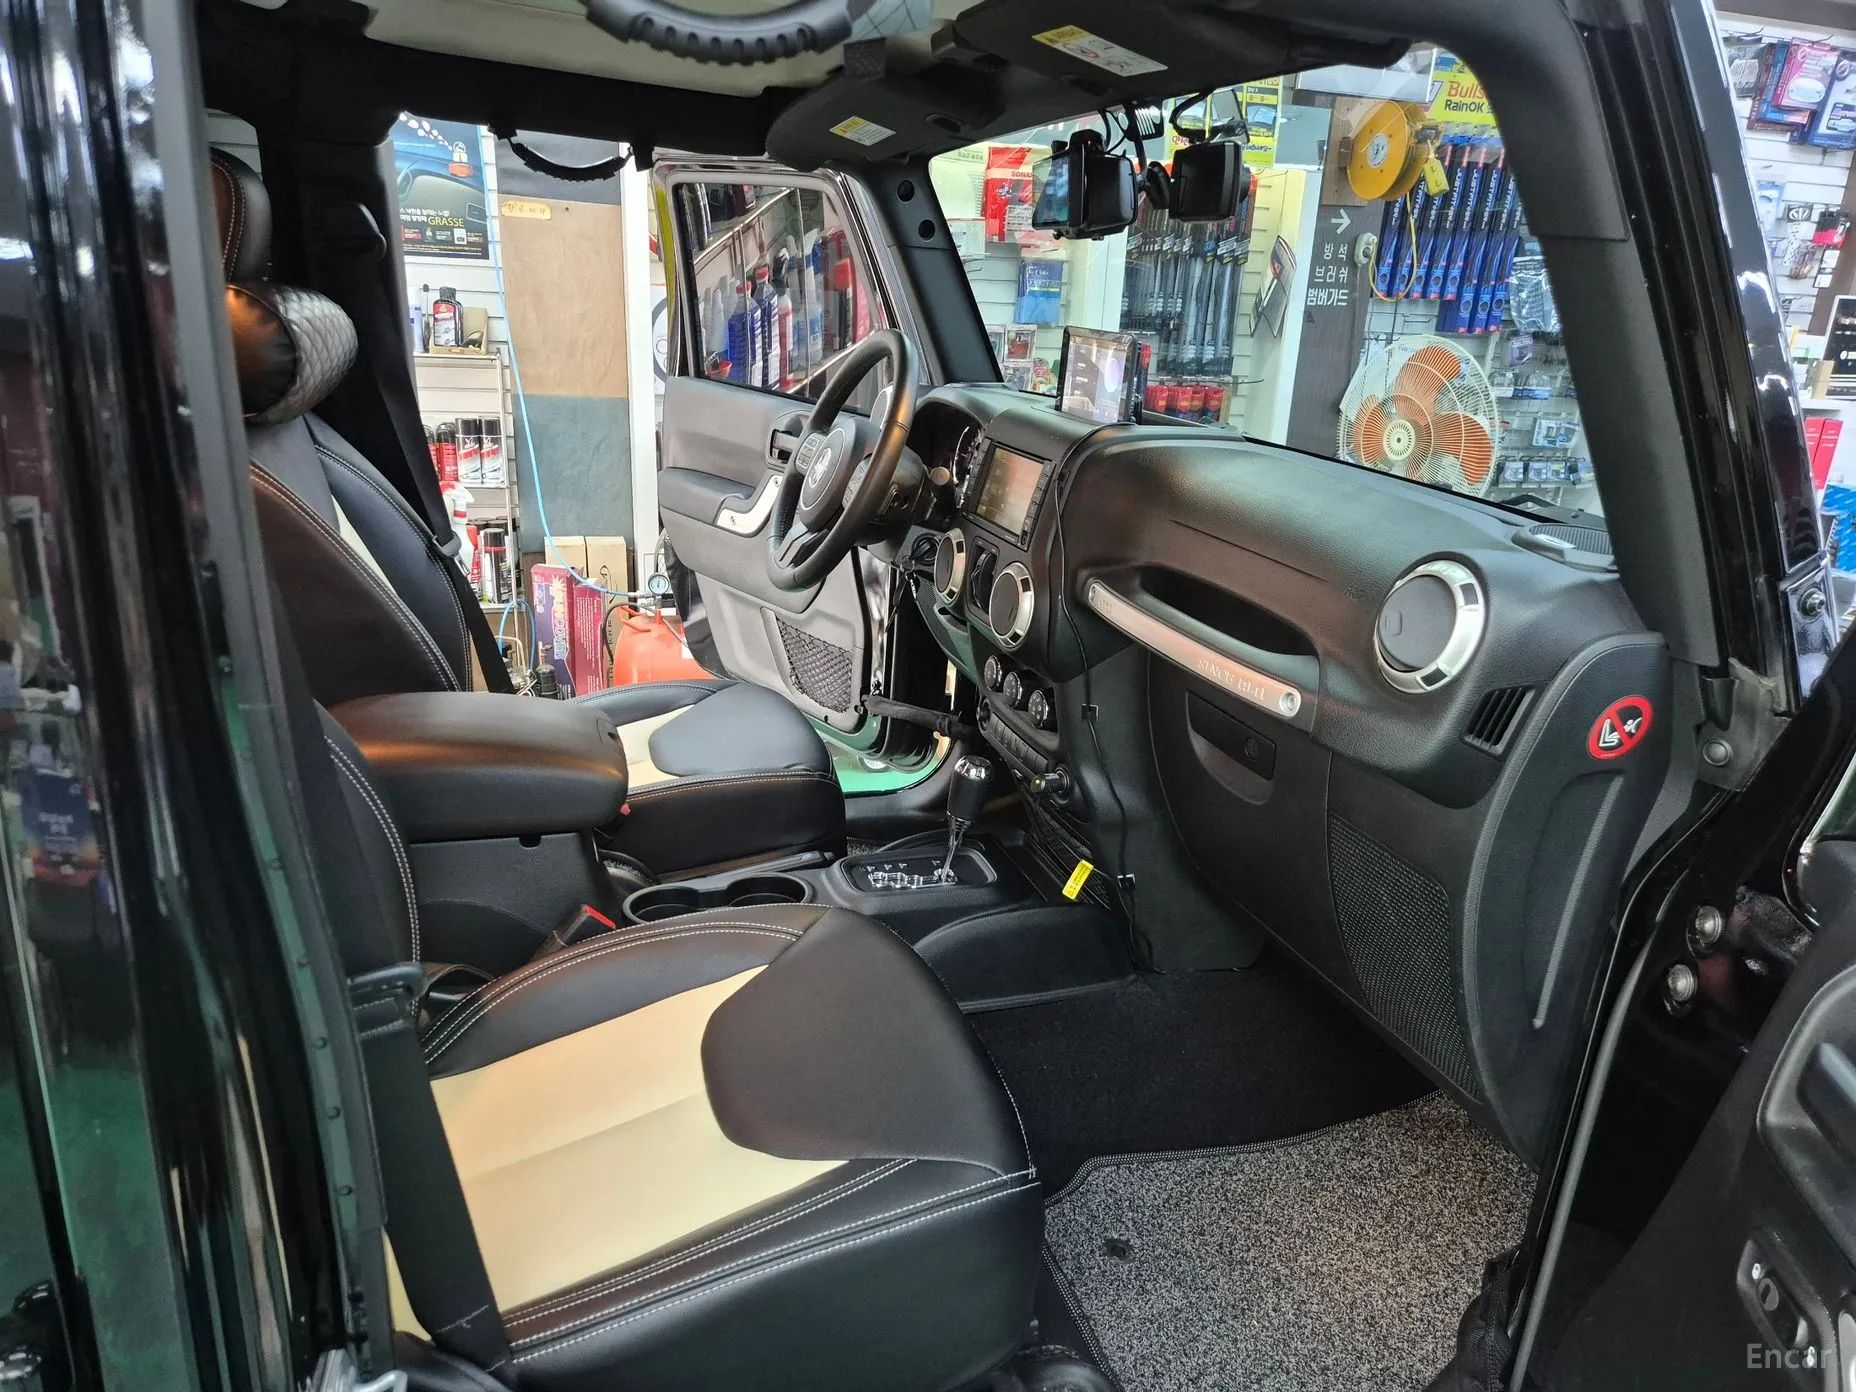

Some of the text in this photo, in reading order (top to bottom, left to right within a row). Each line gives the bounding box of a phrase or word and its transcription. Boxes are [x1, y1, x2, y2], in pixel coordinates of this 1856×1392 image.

[1447, 81, 1488, 100] Bulls
[1444, 99, 1486, 113] RainOK
[428, 216, 465, 227] GRASSE
[1307, 288, 1349, 306] 범버가드
[1198, 655, 1235, 684] SINCE
